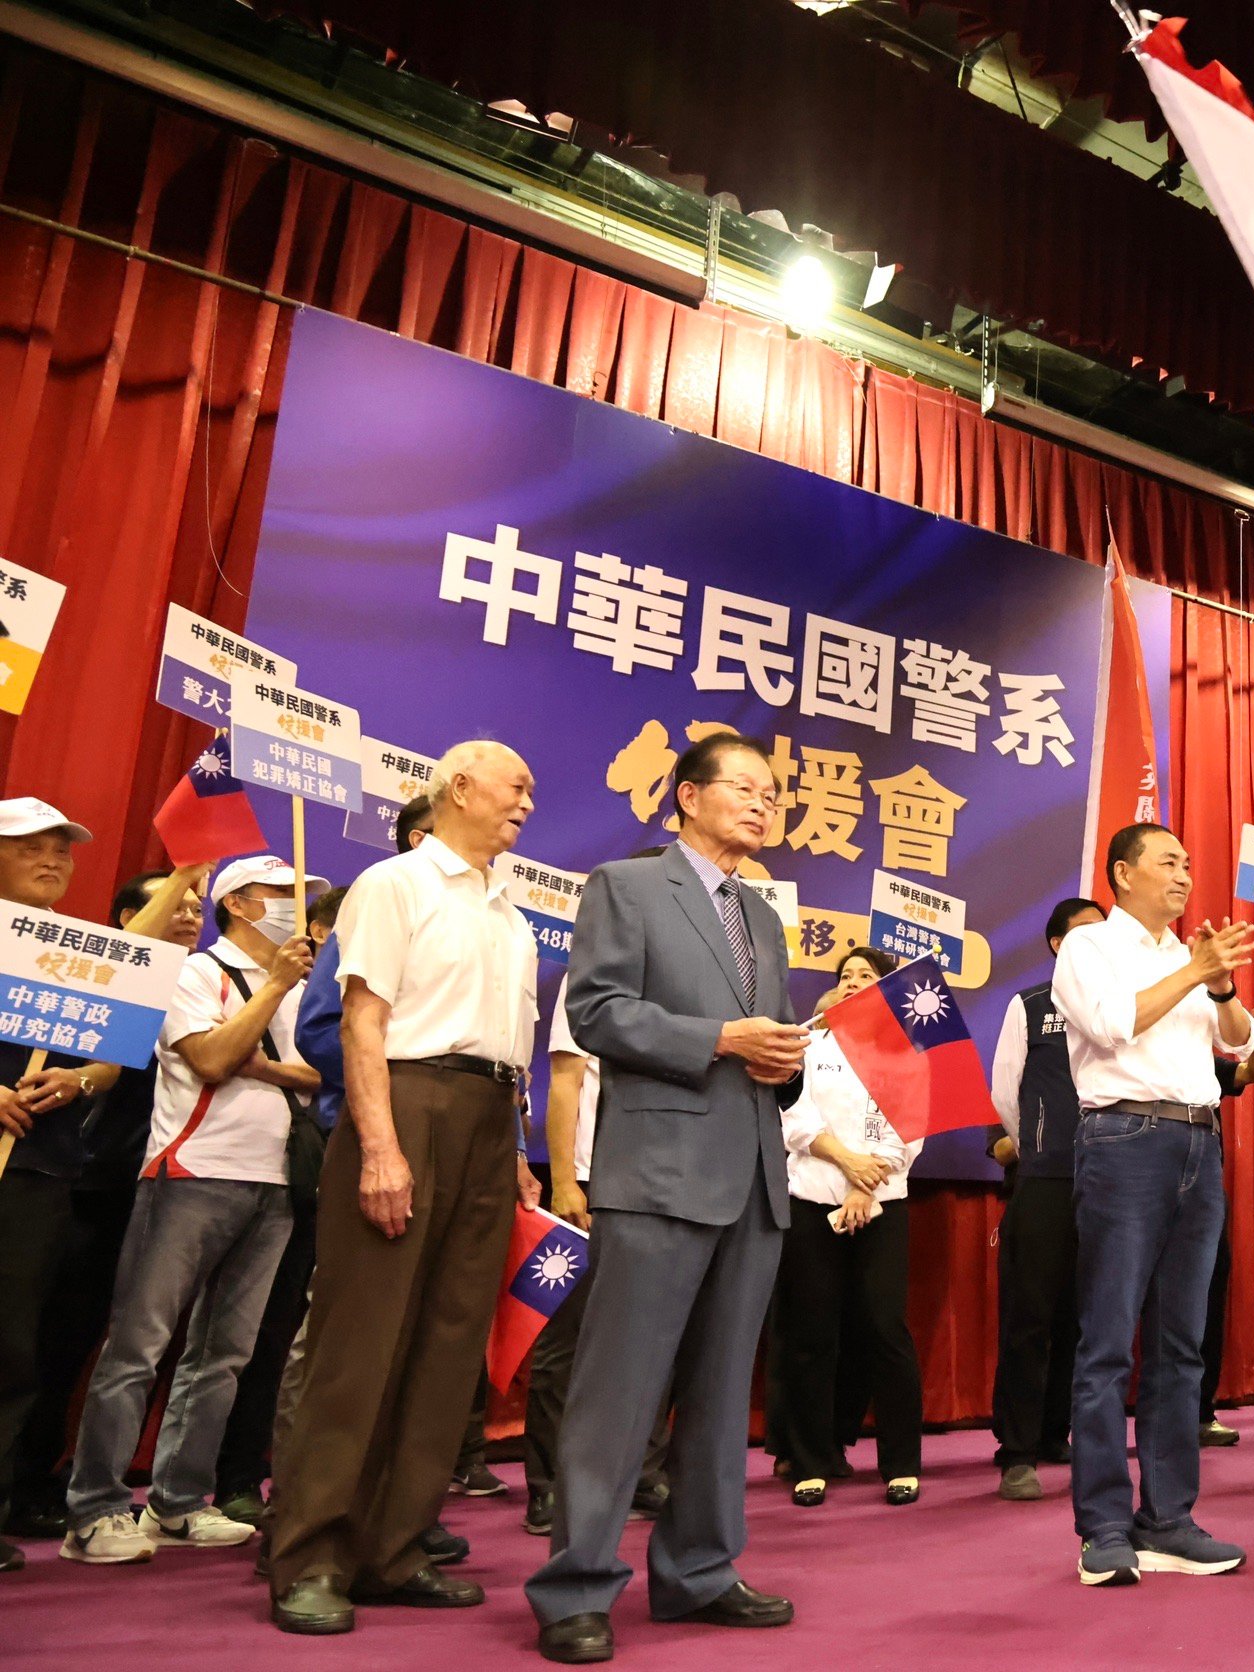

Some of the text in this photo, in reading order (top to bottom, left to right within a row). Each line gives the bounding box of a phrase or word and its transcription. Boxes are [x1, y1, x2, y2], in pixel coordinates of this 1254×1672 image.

[191, 623, 277, 675] 中華民國警系
[439, 523, 1075, 768] 中華民國警系
[255, 683, 342, 727] 中華民國警系
[252, 759, 348, 803] 犯罪矯正協會
[269, 742, 331, 777] 中華民國
[513, 863, 585, 898] 中華民國警系
[889, 881, 951, 914] 中華民國警系
[10, 916, 152, 967] 中華民國警系
[7, 985, 113, 1027] 中華警政
[0, 1011, 103, 1053] 研究協會
